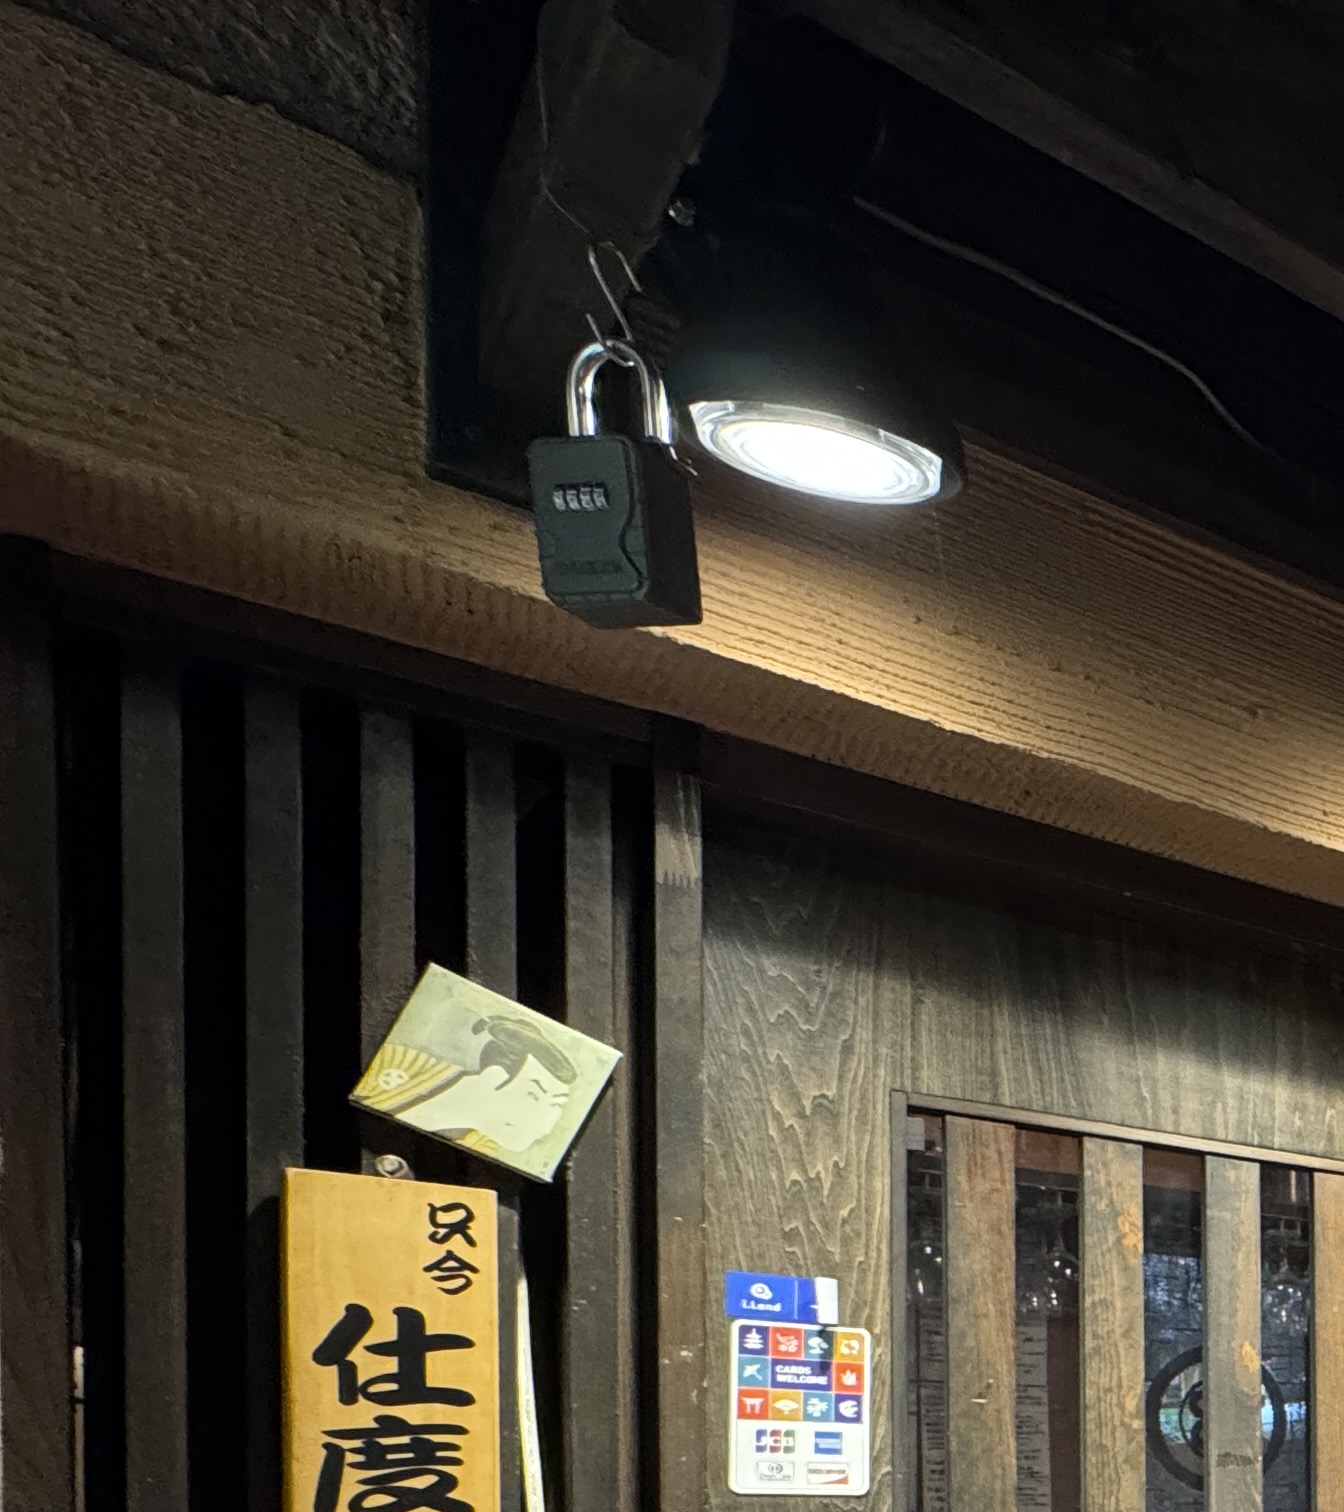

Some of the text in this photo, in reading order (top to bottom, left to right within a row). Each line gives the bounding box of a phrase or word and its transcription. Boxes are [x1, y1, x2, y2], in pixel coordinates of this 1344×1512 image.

[423, 1202, 479, 1296] 只今
[775, 1365, 812, 1374] CARDS
[777, 1374, 828, 1385] WELCOME
